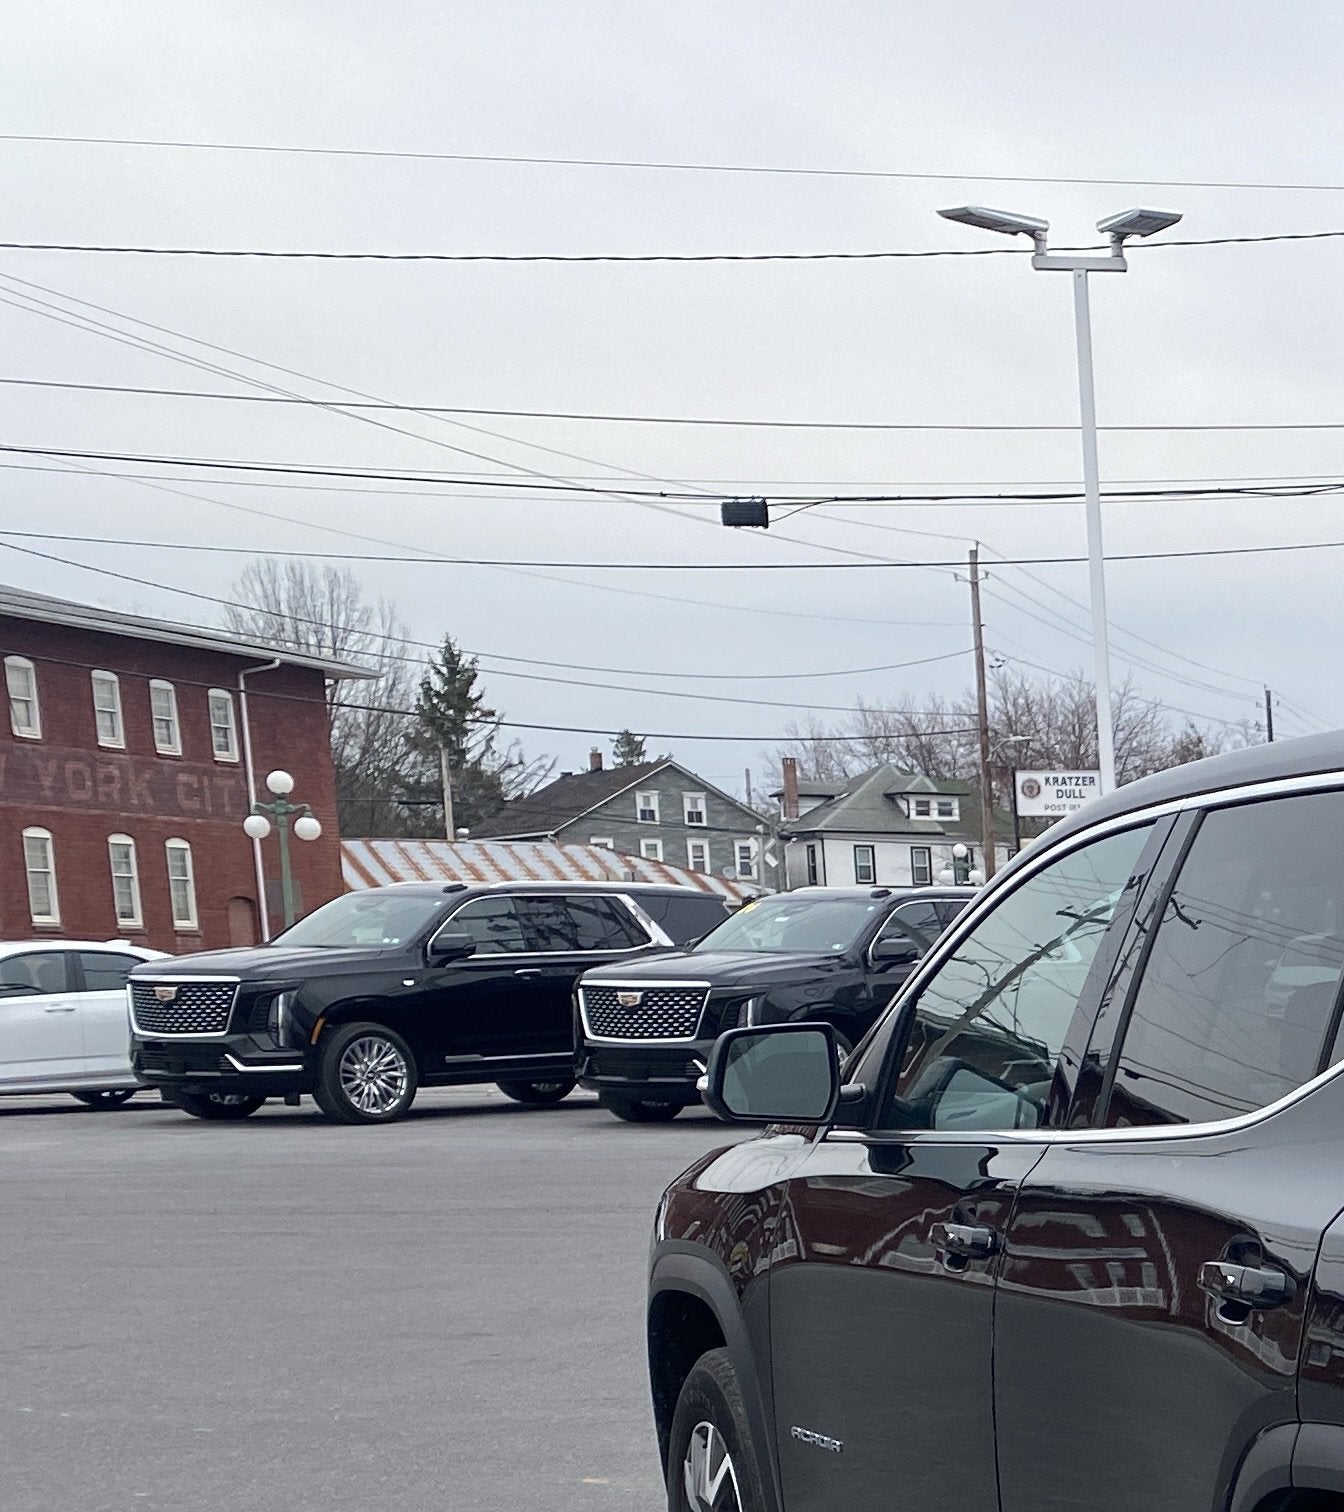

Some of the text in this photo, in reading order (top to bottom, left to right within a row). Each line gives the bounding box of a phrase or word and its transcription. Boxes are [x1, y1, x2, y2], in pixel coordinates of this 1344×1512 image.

[1044, 776, 1096, 787] KRATZER
[1056, 789, 1087, 799] DULL
[1044, 803, 1066, 812] POST
[791, 1425, 843, 1453] ACADIA
